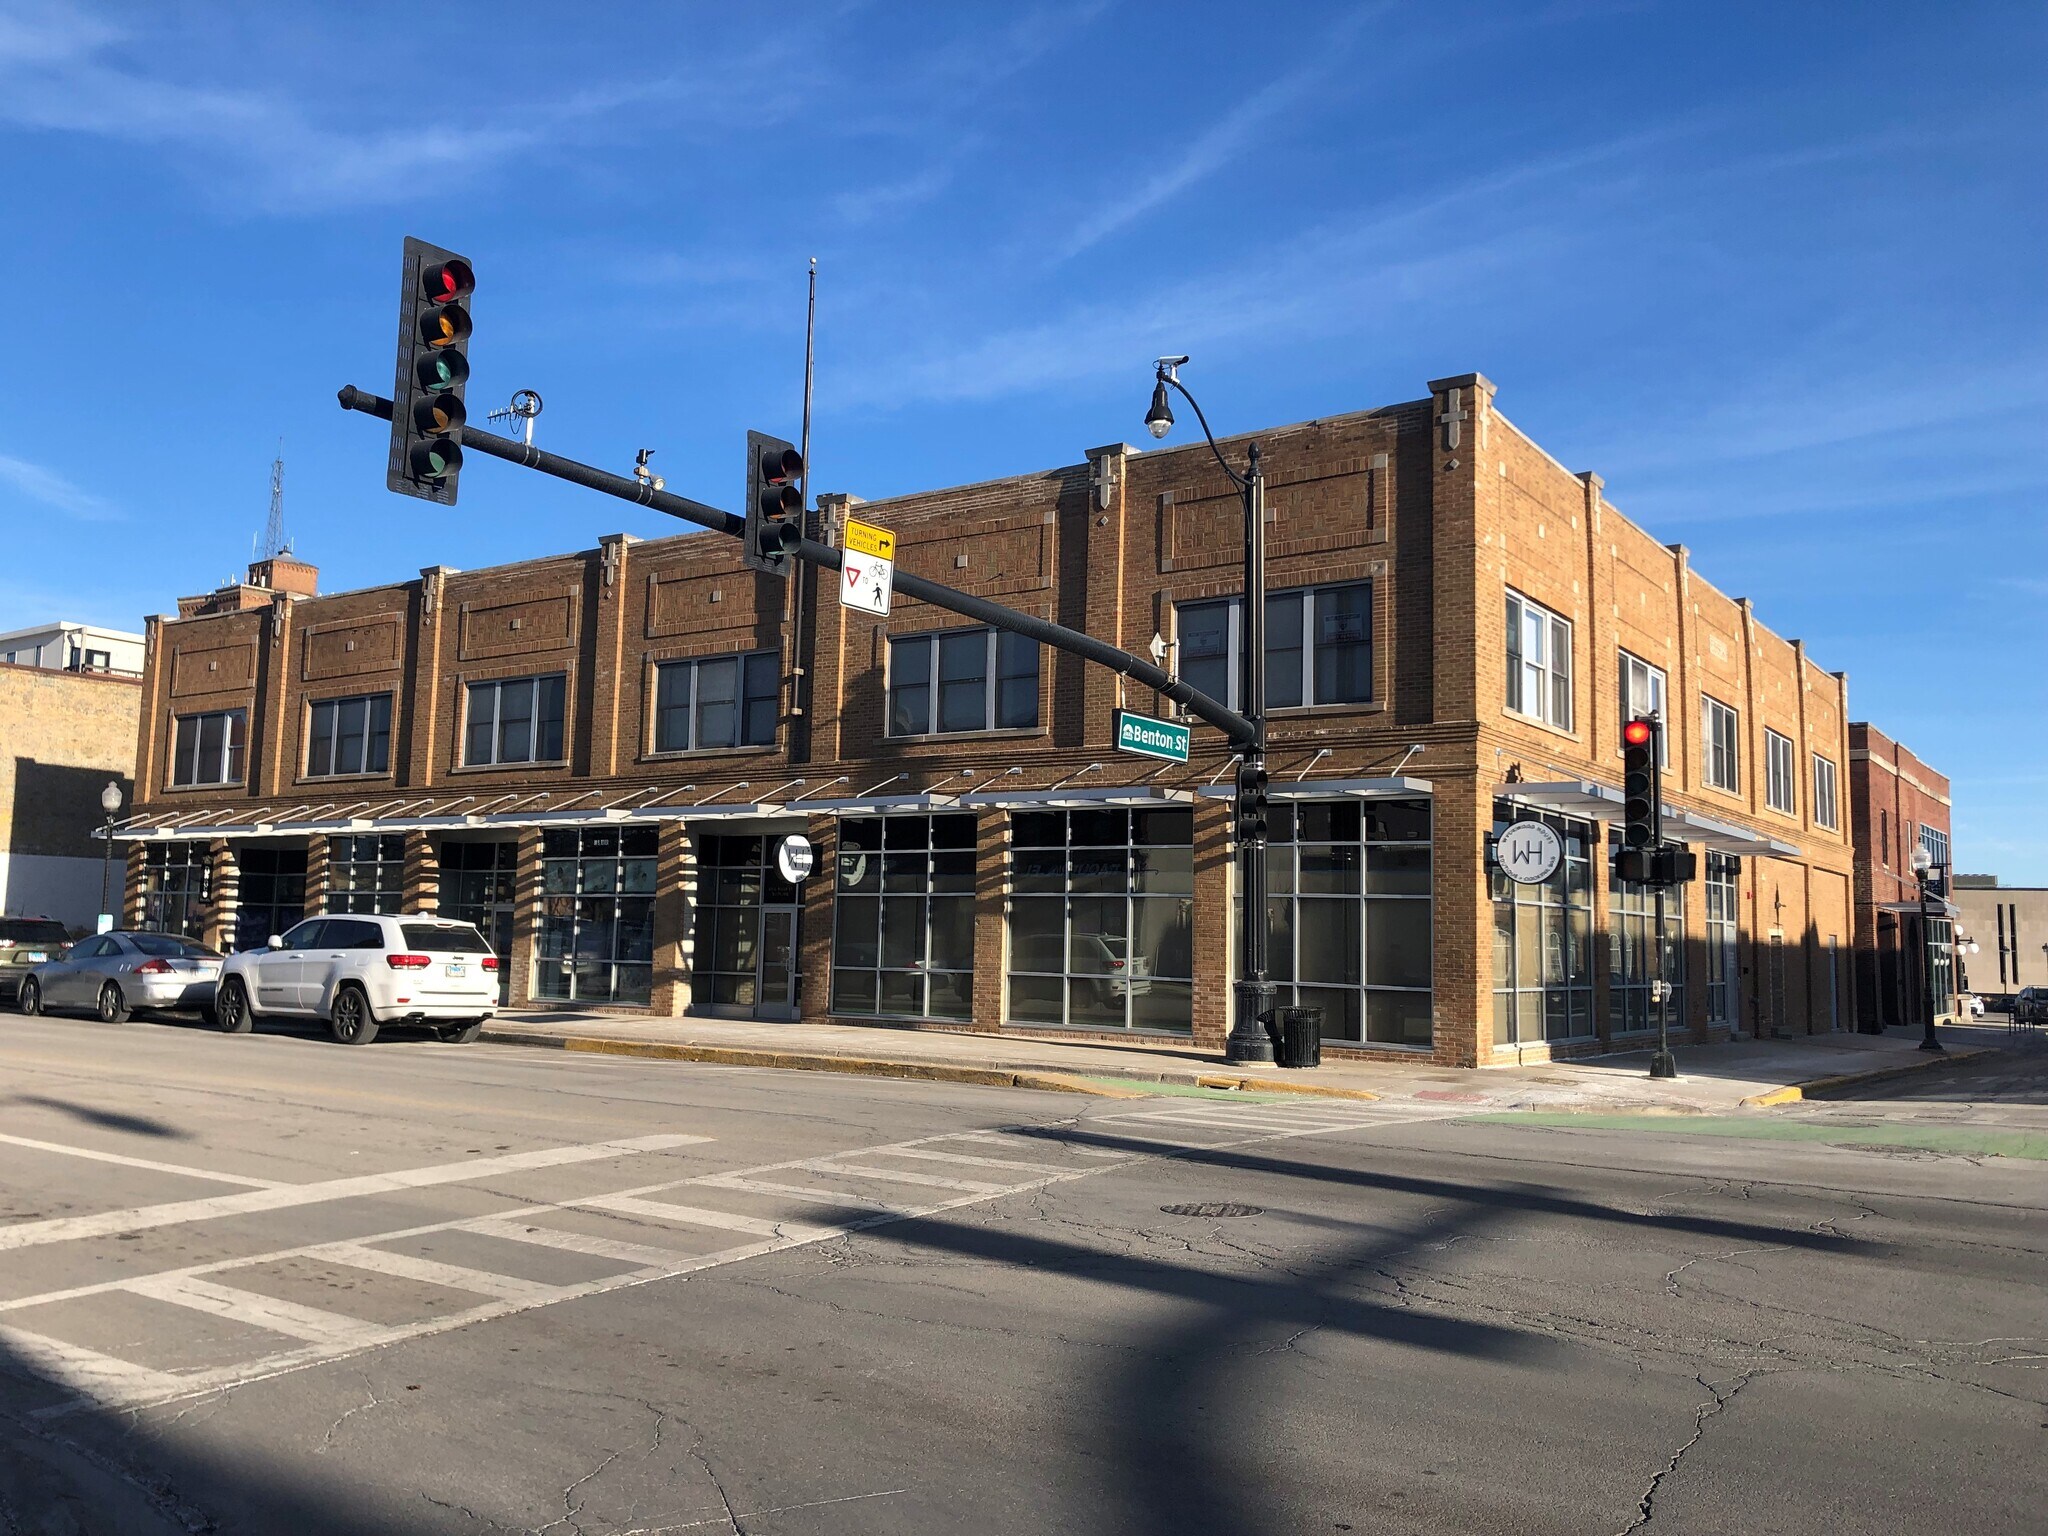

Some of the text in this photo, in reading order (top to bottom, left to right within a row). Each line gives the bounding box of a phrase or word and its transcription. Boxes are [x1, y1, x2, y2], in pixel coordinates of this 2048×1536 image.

[850, 526, 877, 541] TURNING
[848, 536, 878, 552] VEHICLES
[862, 576, 869, 585] TO
[1134, 725, 1187, 752] Benton St
[1536, 826, 1555, 845] HOUSE
[1512, 839, 1543, 865] WH
